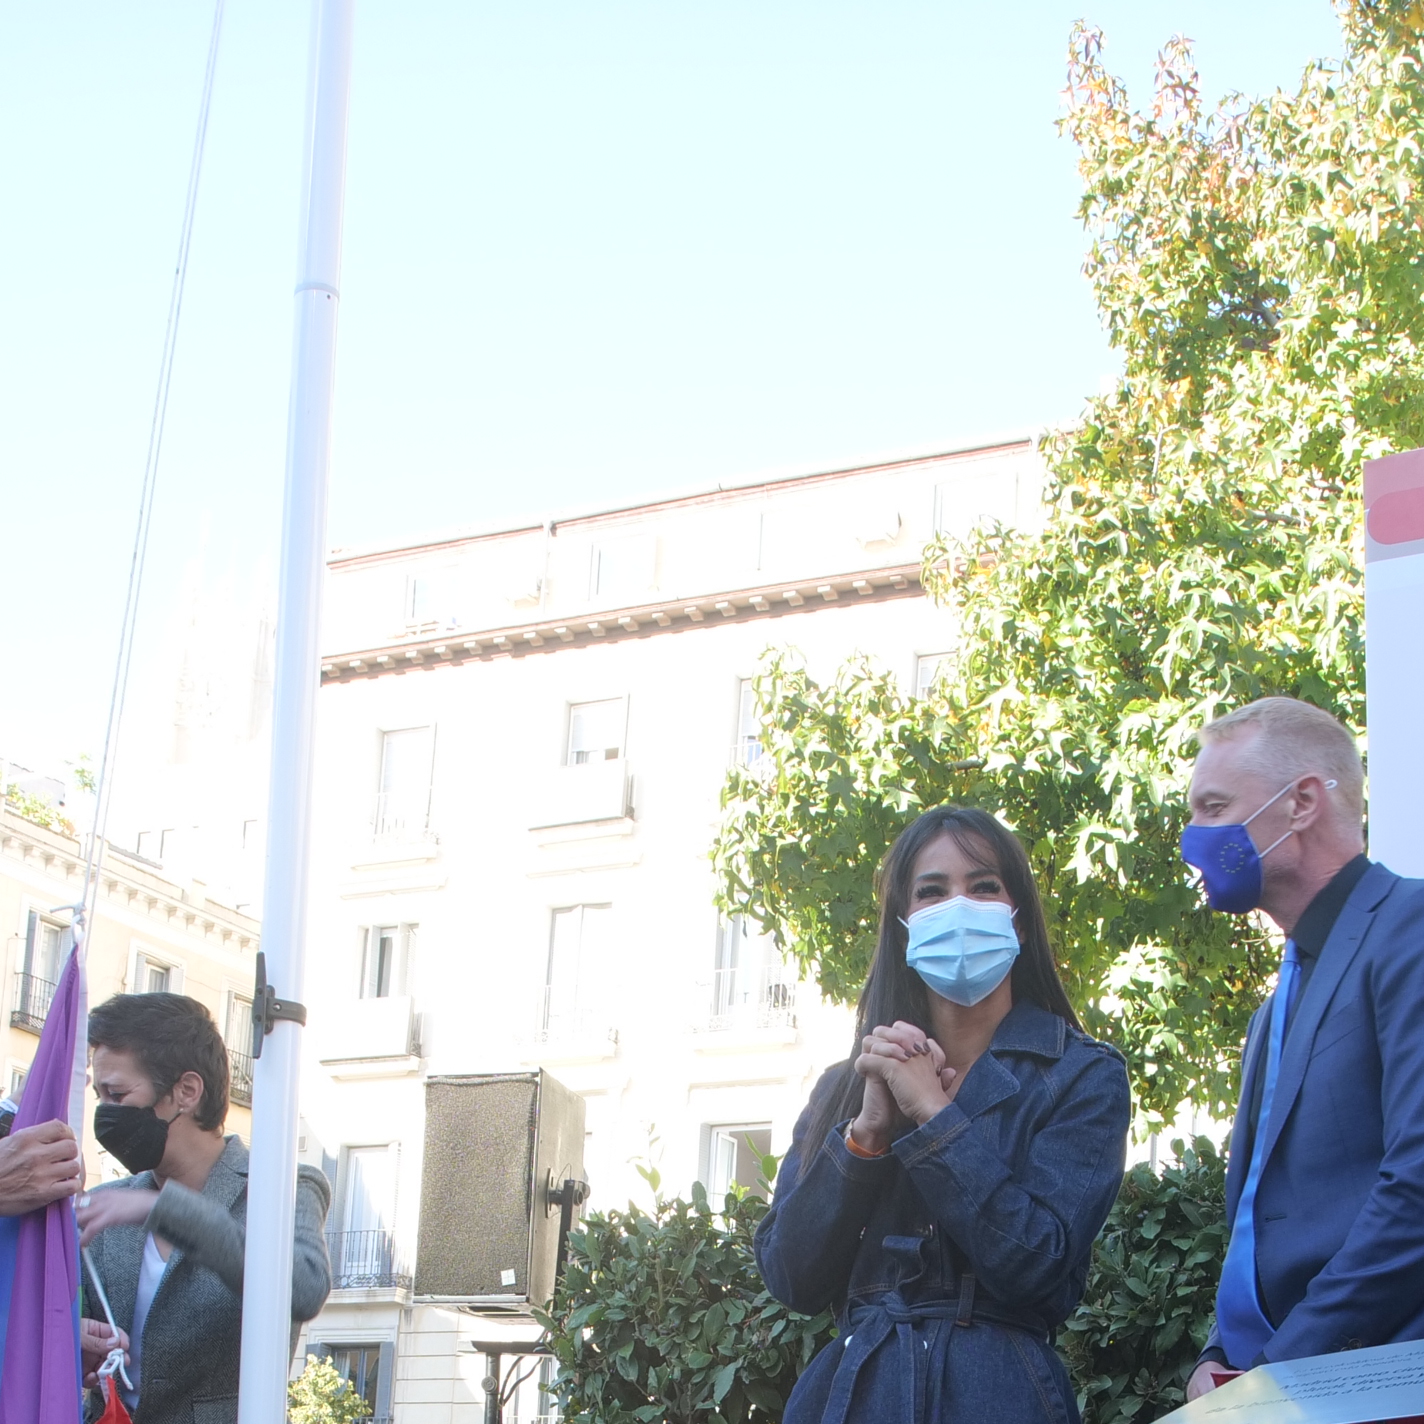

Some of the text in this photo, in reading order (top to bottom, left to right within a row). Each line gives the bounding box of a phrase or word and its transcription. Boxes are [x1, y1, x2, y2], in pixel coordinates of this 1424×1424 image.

[1279, 1376, 1342, 1390] Madrid
[1341, 1370, 1390, 1381] como
[1294, 1382, 1348, 1396] plural,
[1351, 1373, 1414, 1386] diversa
